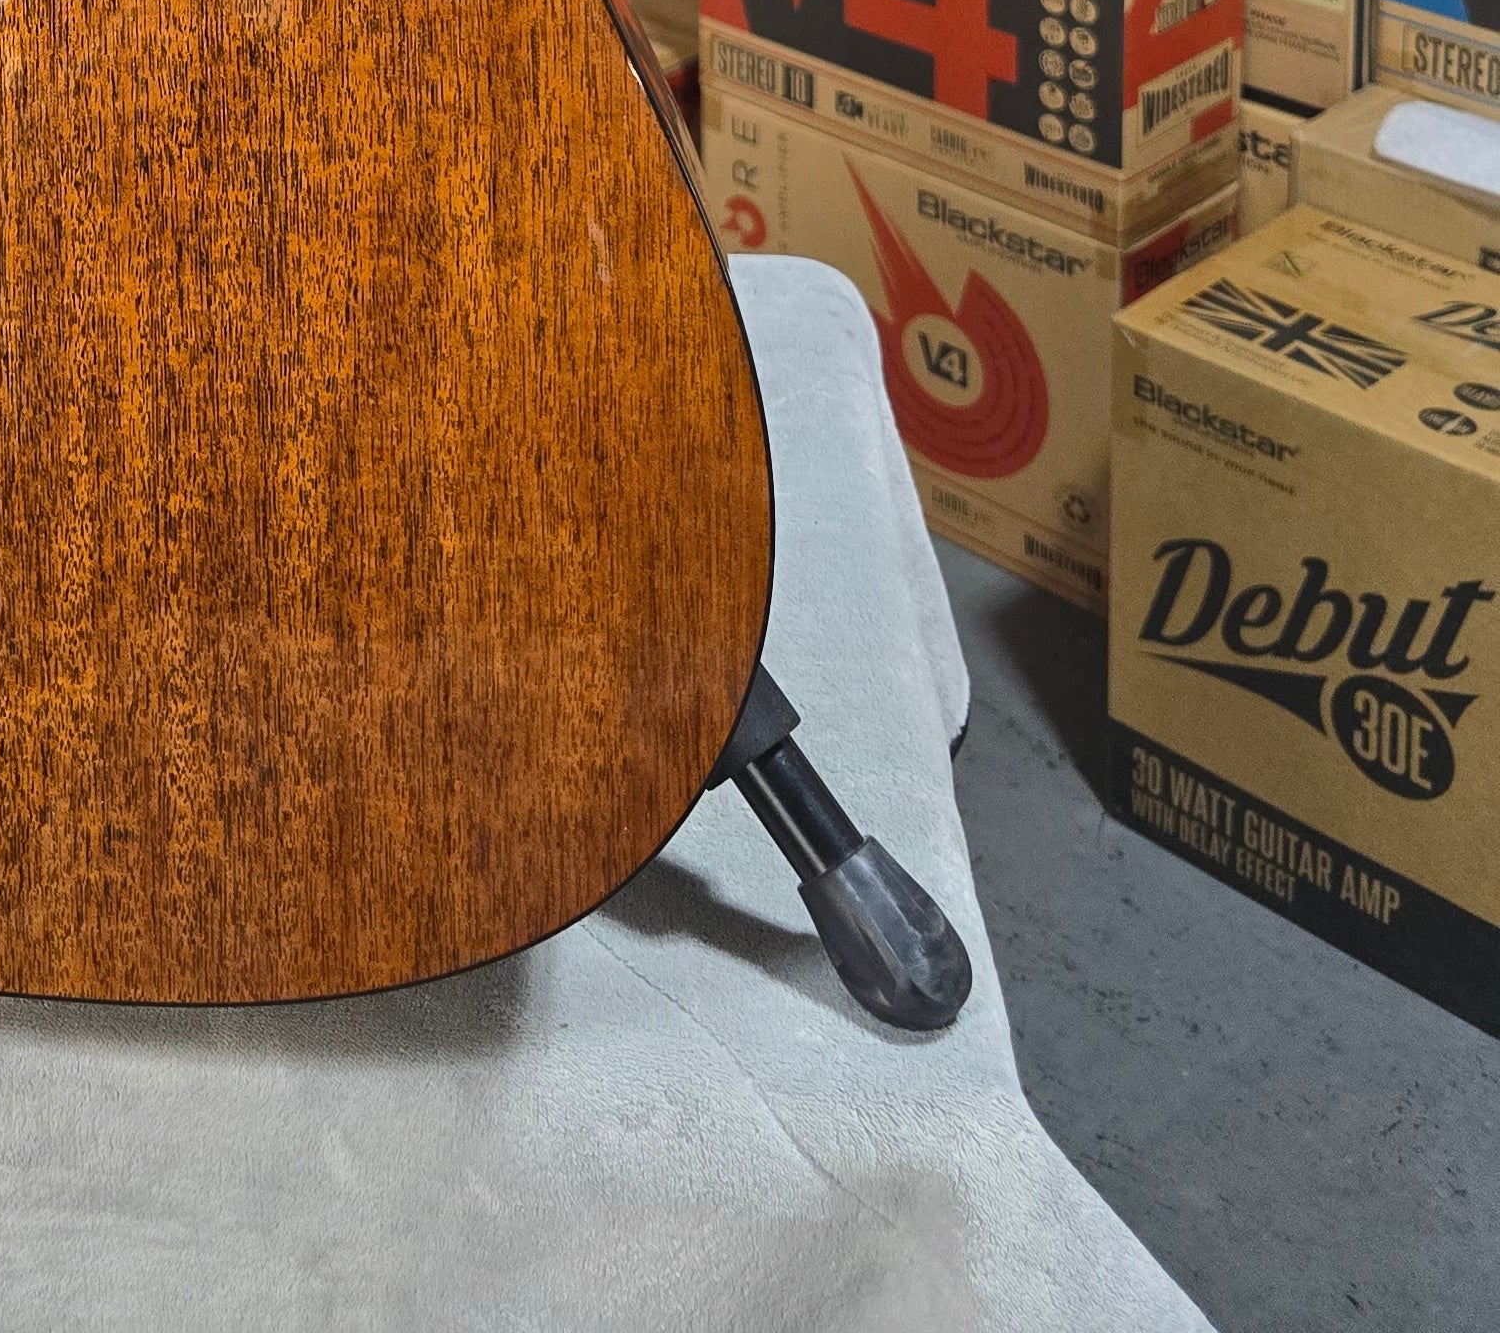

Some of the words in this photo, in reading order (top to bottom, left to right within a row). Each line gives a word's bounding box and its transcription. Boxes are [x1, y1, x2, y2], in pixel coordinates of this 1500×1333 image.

[718, 41, 777, 94] STEREO
[1141, 47, 1231, 136] WIDESTEREO
[1413, 32, 1500, 98] STEREO
[917, 189, 1087, 276] Blackstar
[1134, 374, 1297, 462] Blackstar
[1138, 538, 1496, 679] Debut
[1353, 690, 1434, 792] 30E
[1131, 747, 1164, 796] 30
[1169, 765, 1238, 837] WATT
[1243, 809, 1335, 894] GUITAR
[1340, 863, 1401, 926] AMP
[1131, 787, 1176, 833] WITH
[1179, 808, 1232, 866] DELAY
[1235, 845, 1297, 903] EFFECT
